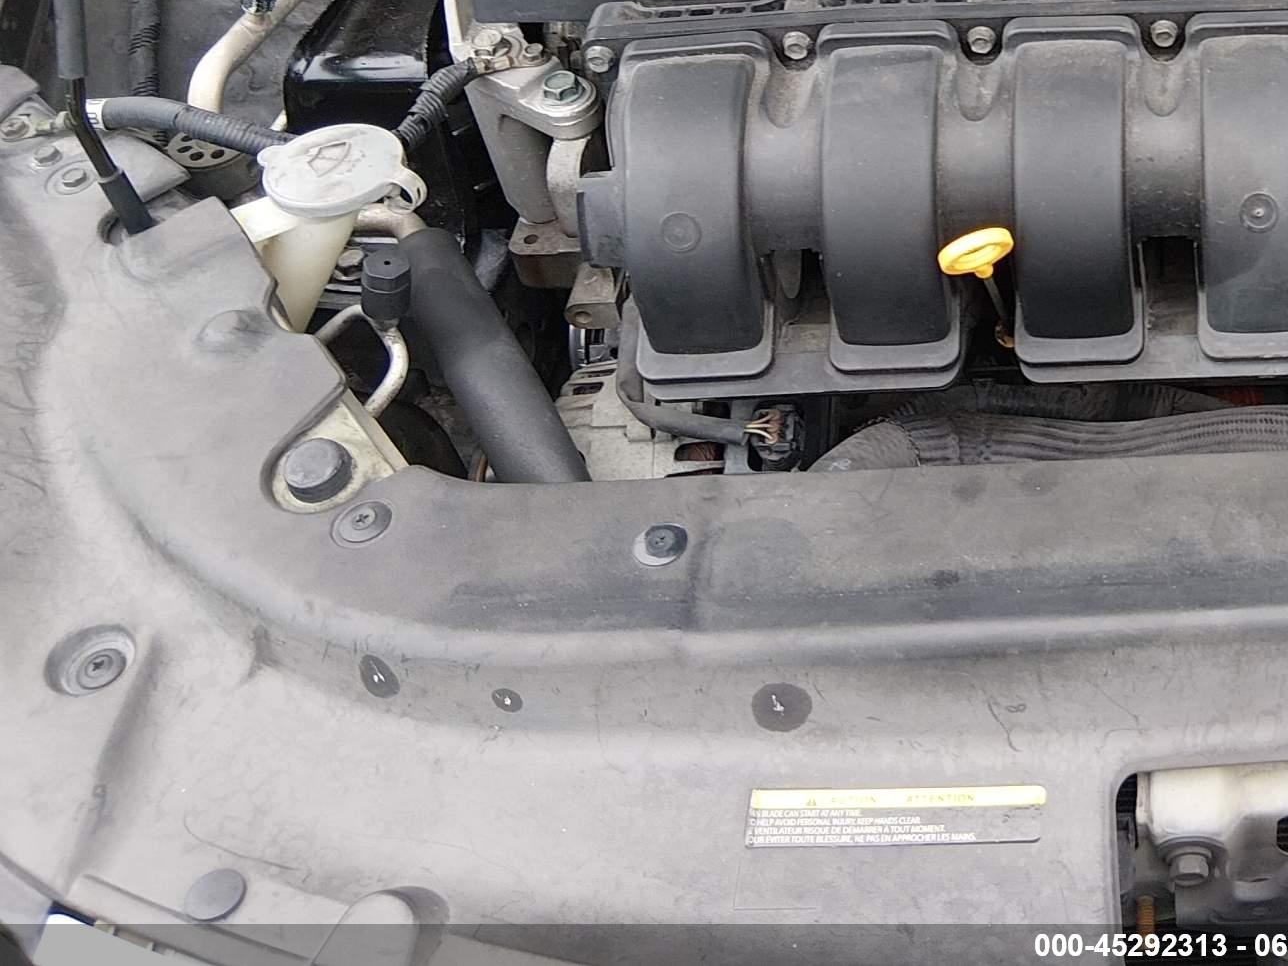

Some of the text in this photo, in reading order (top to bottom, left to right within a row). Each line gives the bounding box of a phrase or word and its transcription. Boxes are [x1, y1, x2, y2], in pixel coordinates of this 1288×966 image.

[784, 809, 799, 818] CAN
[800, 809, 820, 817] START
[830, 809, 844, 817] ANY
[757, 818, 774, 827] HELP
[775, 818, 796, 826] AVOID
[797, 818, 831, 826] PERSONAL
[857, 817, 874, 826] KEEP
[874, 816, 898, 825] HANDS
[754, 826, 803, 835] VENTILATEUR
[804, 826, 830, 835] RISQUE
[890, 824, 910, 833] TOUT
[791, 835, 815, 843] TOUTE
[866, 834, 881, 843] PAS
[892, 833, 937, 842] APPROCHER
